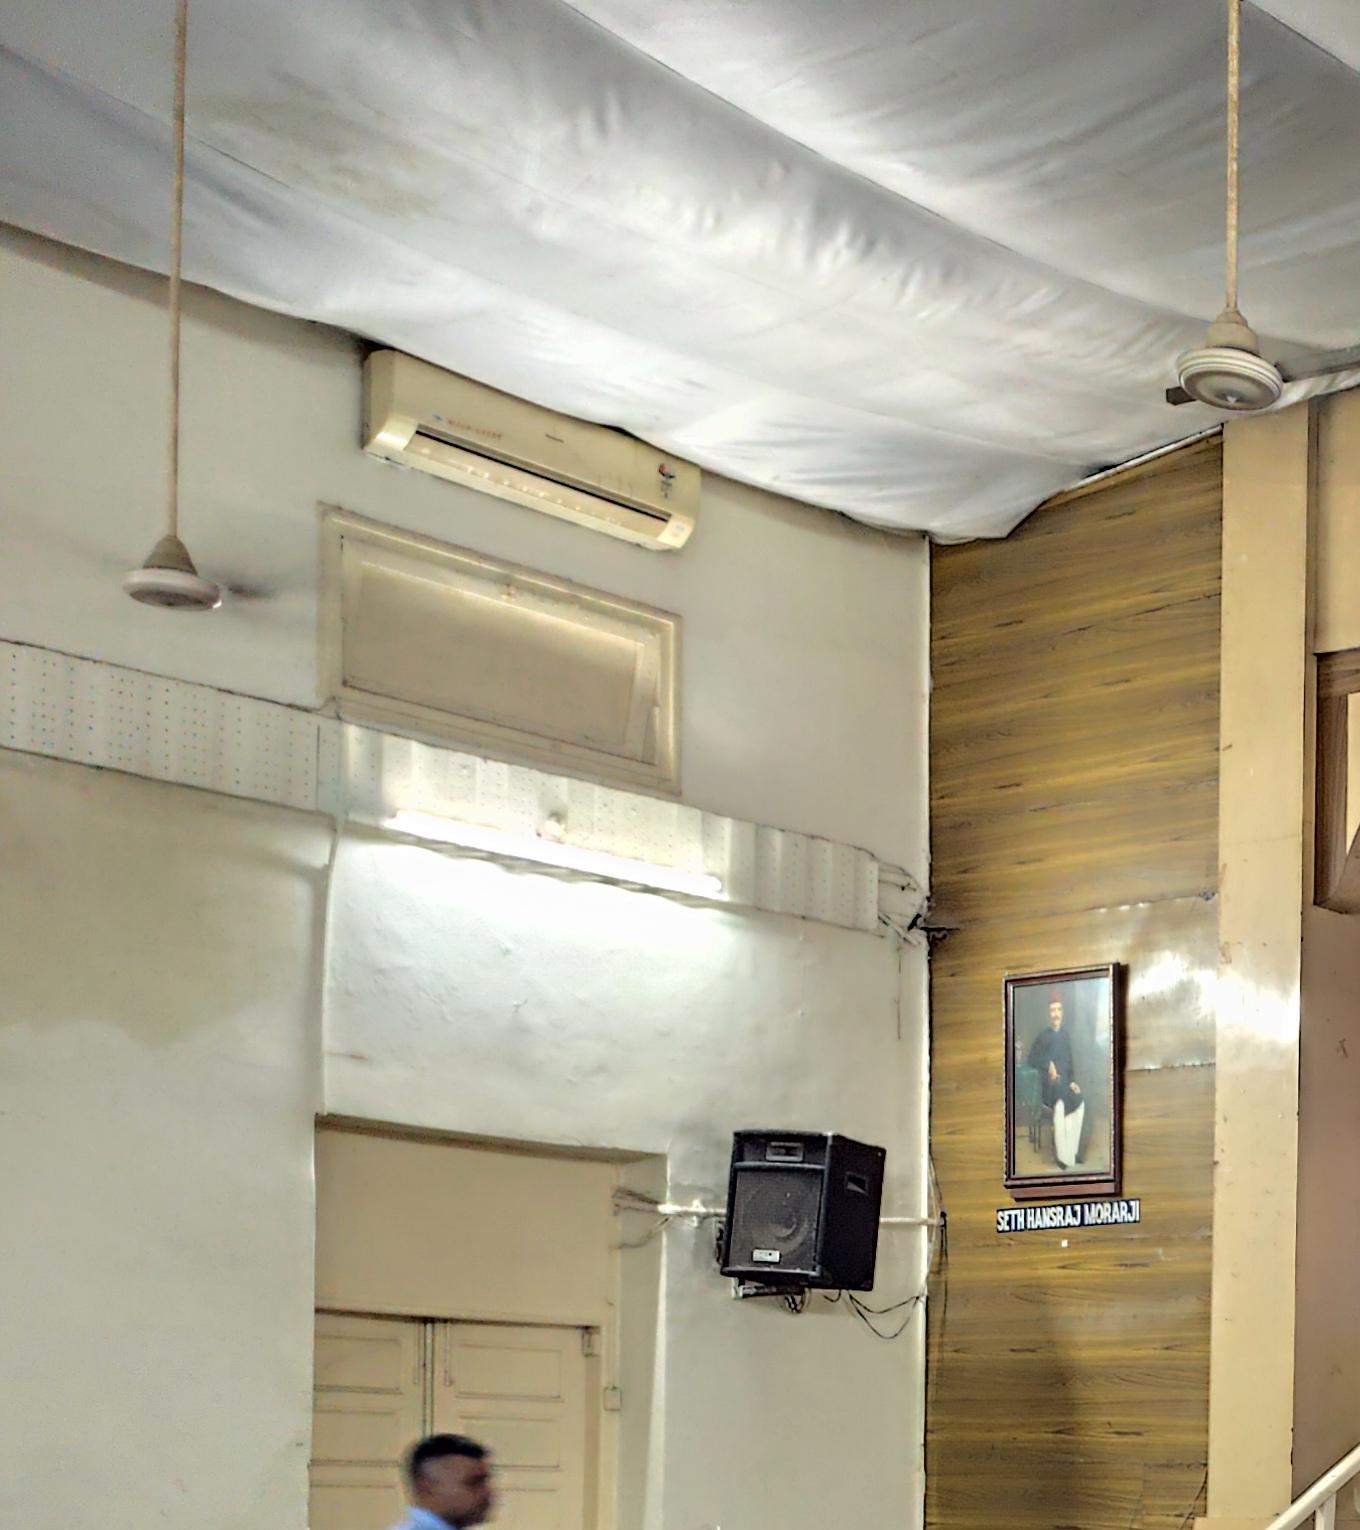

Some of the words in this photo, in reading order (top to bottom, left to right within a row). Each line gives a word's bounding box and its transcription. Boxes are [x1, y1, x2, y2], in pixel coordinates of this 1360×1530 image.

[997, 1209, 1025, 1232] SETH
[1026, 1204, 1081, 1230] HANSRAJ
[1084, 1200, 1140, 1225] MORARJI
